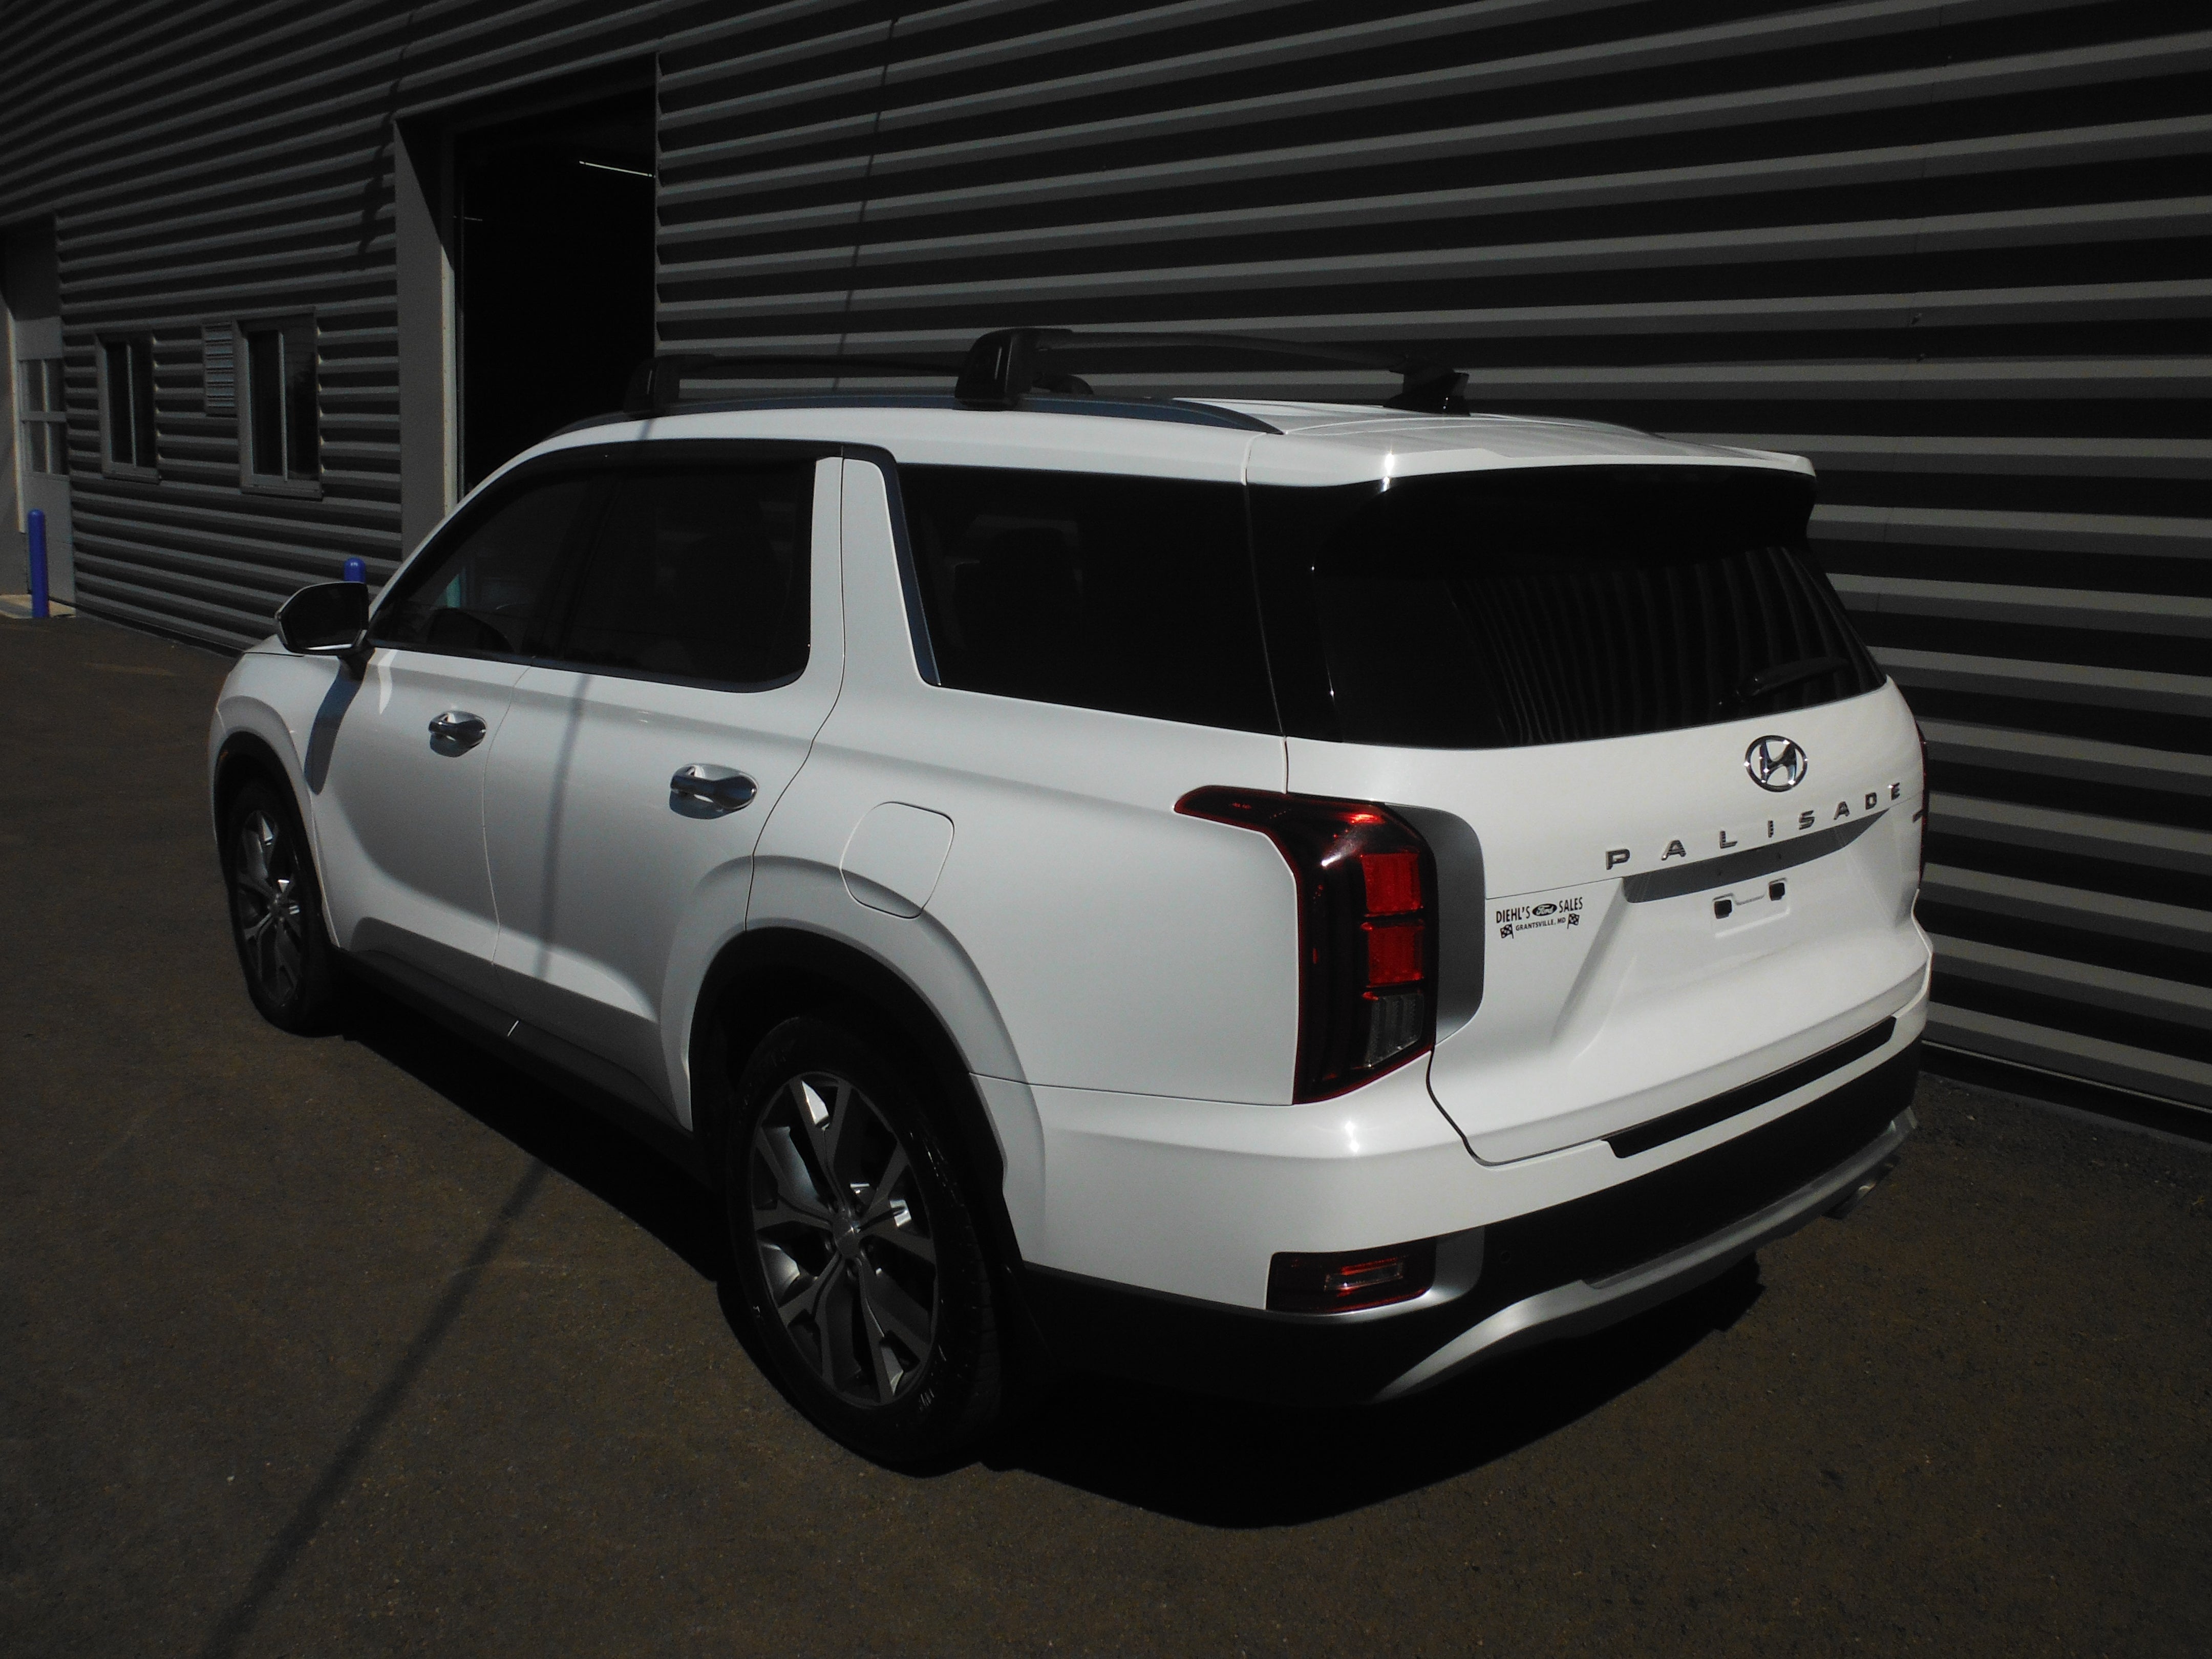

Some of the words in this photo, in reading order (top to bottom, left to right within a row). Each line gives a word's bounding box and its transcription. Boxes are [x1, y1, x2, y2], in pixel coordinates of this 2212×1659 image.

[1605, 782, 1901, 870] PALISADE
[1496, 906, 1530, 923] DIEHL'S
[1535, 904, 1555, 916] Ford
[1559, 897, 1583, 913] SALES
